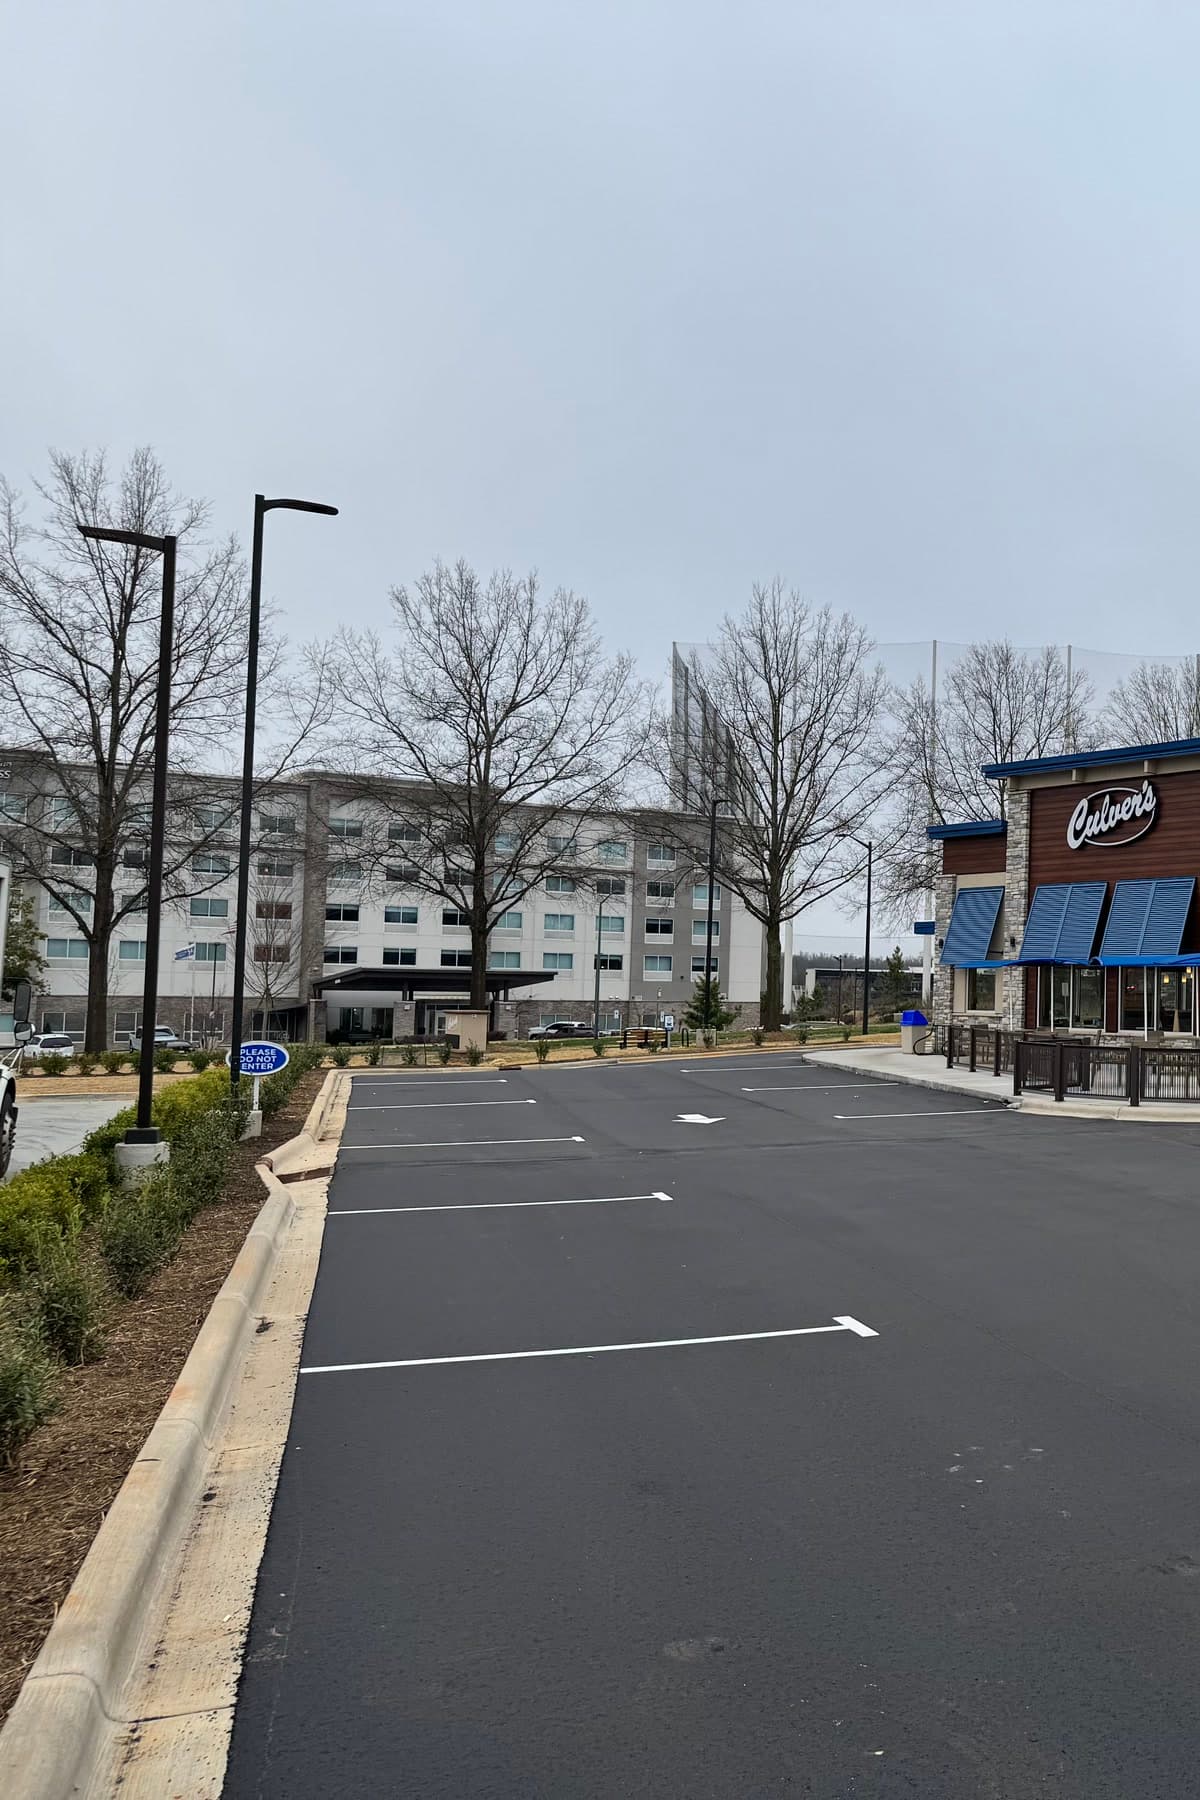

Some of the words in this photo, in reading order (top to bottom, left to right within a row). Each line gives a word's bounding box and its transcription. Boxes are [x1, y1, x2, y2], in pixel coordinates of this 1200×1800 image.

[1067, 780, 1156, 849] Culver's
[240, 1048, 277, 1056] PLEASE
[256, 1055, 278, 1063] NOT
[241, 1062, 274, 1070] ENTER
